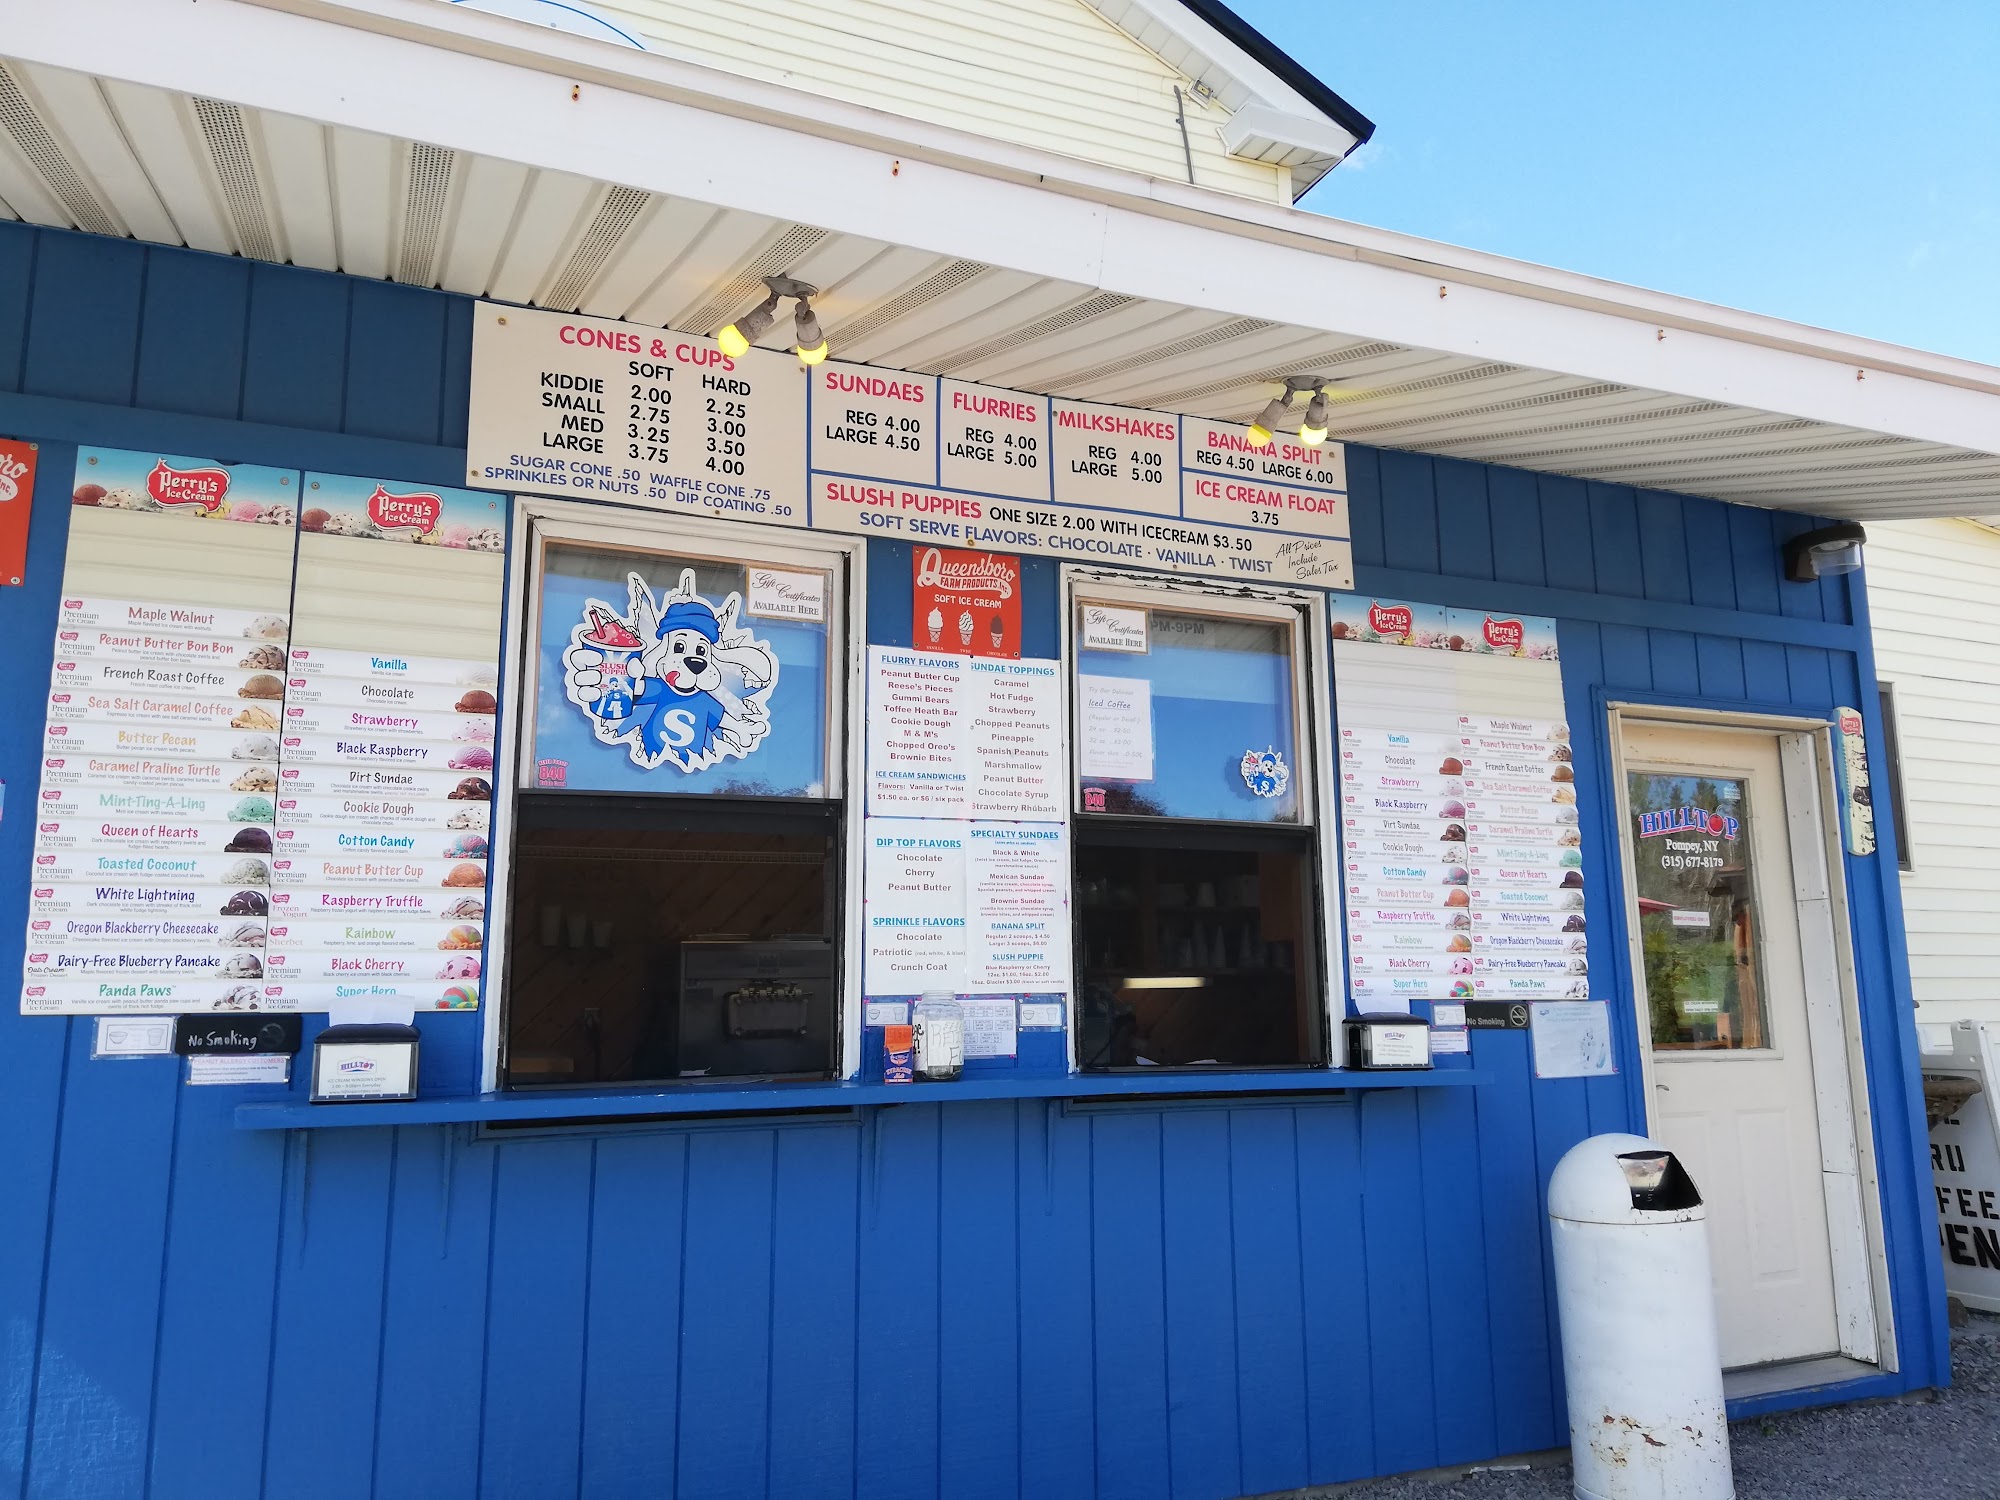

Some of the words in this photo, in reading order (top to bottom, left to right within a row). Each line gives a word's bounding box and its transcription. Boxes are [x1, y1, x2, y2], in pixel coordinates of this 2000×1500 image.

[560, 325, 641, 353] CONES
[650, 339, 667, 359] &
[675, 344, 735, 372] CUPS
[629, 361, 674, 382] SOFT
[702, 375, 750, 396] HARD
[541, 372, 604, 394] KIDDIE
[631, 384, 671, 405] 2.00
[706, 398, 746, 419] 2.25
[825, 372, 925, 403] SUNDAES
[542, 393, 605, 414] SMALL
[630, 405, 670, 424] 2.75
[707, 418, 745, 438] 3.00
[952, 392, 1037, 424] FLURRIES
[846, 409, 878, 427] REG
[884, 414, 920, 433] 4.00
[1059, 410, 1175, 441] MILKSHAKES
[561, 415, 604, 433] MED
[628, 424, 670, 444] 3.25
[706, 437, 745, 457] 3.50
[825, 424, 879, 445] LARGE
[884, 432, 920, 452] 4.50
[965, 426, 995, 445] REG
[1005, 433, 1037, 451] 4.00
[543, 432, 604, 454] LARGE
[629, 444, 669, 464] 3.75
[706, 456, 745, 476] 4.00
[947, 442, 995, 462] LARGE
[1004, 450, 1037, 469] 5.00
[1088, 444, 1117, 460] REG
[1131, 451, 1162, 467] 4.00
[1282, 444, 1322, 465] SPLIT
[1071, 459, 1118, 478] LARGE
[1132, 468, 1163, 484] 5.00
[1196, 450, 1223, 466] REG
[1226, 455, 1255, 472] 4.50
[1262, 461, 1301, 481] LARGE
[1305, 468, 1334, 484] 6.00
[159, 471, 218, 491] Perry's
[510, 454, 565, 472] SUGAR
[570, 461, 612, 477] CONE
[617, 466, 640, 481] .50
[650, 472, 702, 491] WAFFLE
[707, 482, 745, 498] CONE
[750, 488, 770, 500] .75
[166, 488, 182, 499] Ice
[182, 490, 215, 502] Cream
[485, 466, 568, 486] SPRINKLES
[572, 475, 594, 489] OR
[599, 479, 639, 495] NUTS
[644, 487, 666, 499] .50
[676, 491, 699, 504] DIP
[703, 495, 765, 513] COATING
[770, 504, 792, 517] .50
[1196, 479, 1222, 497] ICE
[1226, 485, 1283, 507] CREAM
[1288, 494, 1336, 515] FLOAT
[827, 483, 896, 510] SLUSH
[902, 493, 982, 519] PUPPIES
[989, 507, 1022, 525] ONE
[1026, 511, 1059, 529] SIZE
[1062, 515, 1096, 532] 2.00
[1100, 518, 1137, 536] WITH
[1142, 523, 1210, 546] ICECREAM
[1213, 532, 1252, 552] $3.50
[1251, 510, 1279, 526] 3.75
[859, 512, 905, 533] SOFT
[909, 516, 961, 539] SERVE
[965, 524, 1043, 547] FLAVORS:
[1048, 534, 1143, 558] CHOCOLATE
[1155, 547, 1216, 568] VANILLA
[1229, 556, 1273, 573] TWIST
[1275, 543, 1292, 558] All
[1290, 539, 1322, 557] Prices
[917, 548, 1015, 587] Queensboro
[1287, 555, 1318, 569] Include
[1296, 564, 1323, 581] Sales
[1322, 560, 1339, 574] Tax
[752, 573, 775, 590] Gift
[776, 582, 820, 602] Certificates
[940, 578, 960, 589] FARM
[962, 578, 998, 589] PRODUCTS
[753, 601, 795, 613] AVAILABLE
[797, 605, 819, 616] HERE
[934, 595, 956, 605] SOFT
[958, 597, 972, 605] ICE
[974, 598, 1002, 609] CREAM
[129, 607, 167, 622] Maple
[170, 610, 214, 625] Walnut
[1087, 609, 1106, 624] Gift
[1106, 619, 1143, 636] Certificates
[1088, 635, 1124, 646] AVAILABLE
[1125, 639, 1142, 648] HERE
[372, 658, 407, 670] Vanilla
[881, 655, 915, 666] FLURRY
[918, 657, 959, 668] FLAVORS
[971, 663, 1005, 673] SUNDAE
[1008, 665, 1055, 676] TOPPINGS
[361, 686, 414, 698] Chocolate
[1088, 699, 1103, 707] Iced
[1107, 701, 1130, 710] Coffee
[352, 713, 418, 729] Strawberry
[660, 709, 695, 746] S
[118, 731, 158, 744] Butter
[162, 733, 196, 746] Pecan
[540, 766, 565, 780] 840
[100, 795, 205, 811] Mint-Ting-A-Ling
[101, 824, 139, 838] Queen
[142, 826, 155, 837] of
[159, 827, 198, 838] Hearts
[1639, 806, 1738, 840] HILLTOP
[338, 834, 377, 847] Cotton
[380, 835, 414, 849] Candy
[877, 839, 893, 847] DIP
[896, 839, 916, 847] TOP
[919, 839, 961, 848] FLAVORS
[1665, 839, 1702, 853] Pompey,
[1703, 841, 1719, 851] NY
[97, 857, 143, 870] Toasted
[147, 859, 196, 871] Coconut
[897, 854, 942, 863] Chocolate
[1662, 856, 1684, 869] (315)
[1686, 857, 1723, 868] 677-8179
[906, 868, 934, 878] Cherry
[96, 887, 133, 900] White
[137, 888, 195, 902] Lightning
[888, 883, 921, 892] Peanut
[924, 883, 951, 892] Butter
[67, 920, 102, 935] Oregon
[105, 922, 160, 936] Blackberry
[162, 922, 218, 935] Cheesecake
[873, 917, 920, 926] SPRINKLE
[922, 918, 965, 926] FLAVORS
[346, 927, 395, 939] Rainbow
[58, 954, 116, 968] Dairy-Free
[119, 955, 172, 969] Blueberry
[175, 955, 220, 967] Pancake
[331, 959, 362, 970] Black
[365, 959, 404, 971] Cherry
[1389, 959, 1407, 968] Black
[1408, 959, 1430, 969] Cherry
[1393, 980, 1411, 989] Super
[1412, 980, 1428, 988] Hero
[1476, 1018, 1505, 1027] Smoking
[189, 1034, 202, 1047] No
[207, 1030, 257, 1049] Smoking
[340, 1060, 374, 1073] HILLTOP
